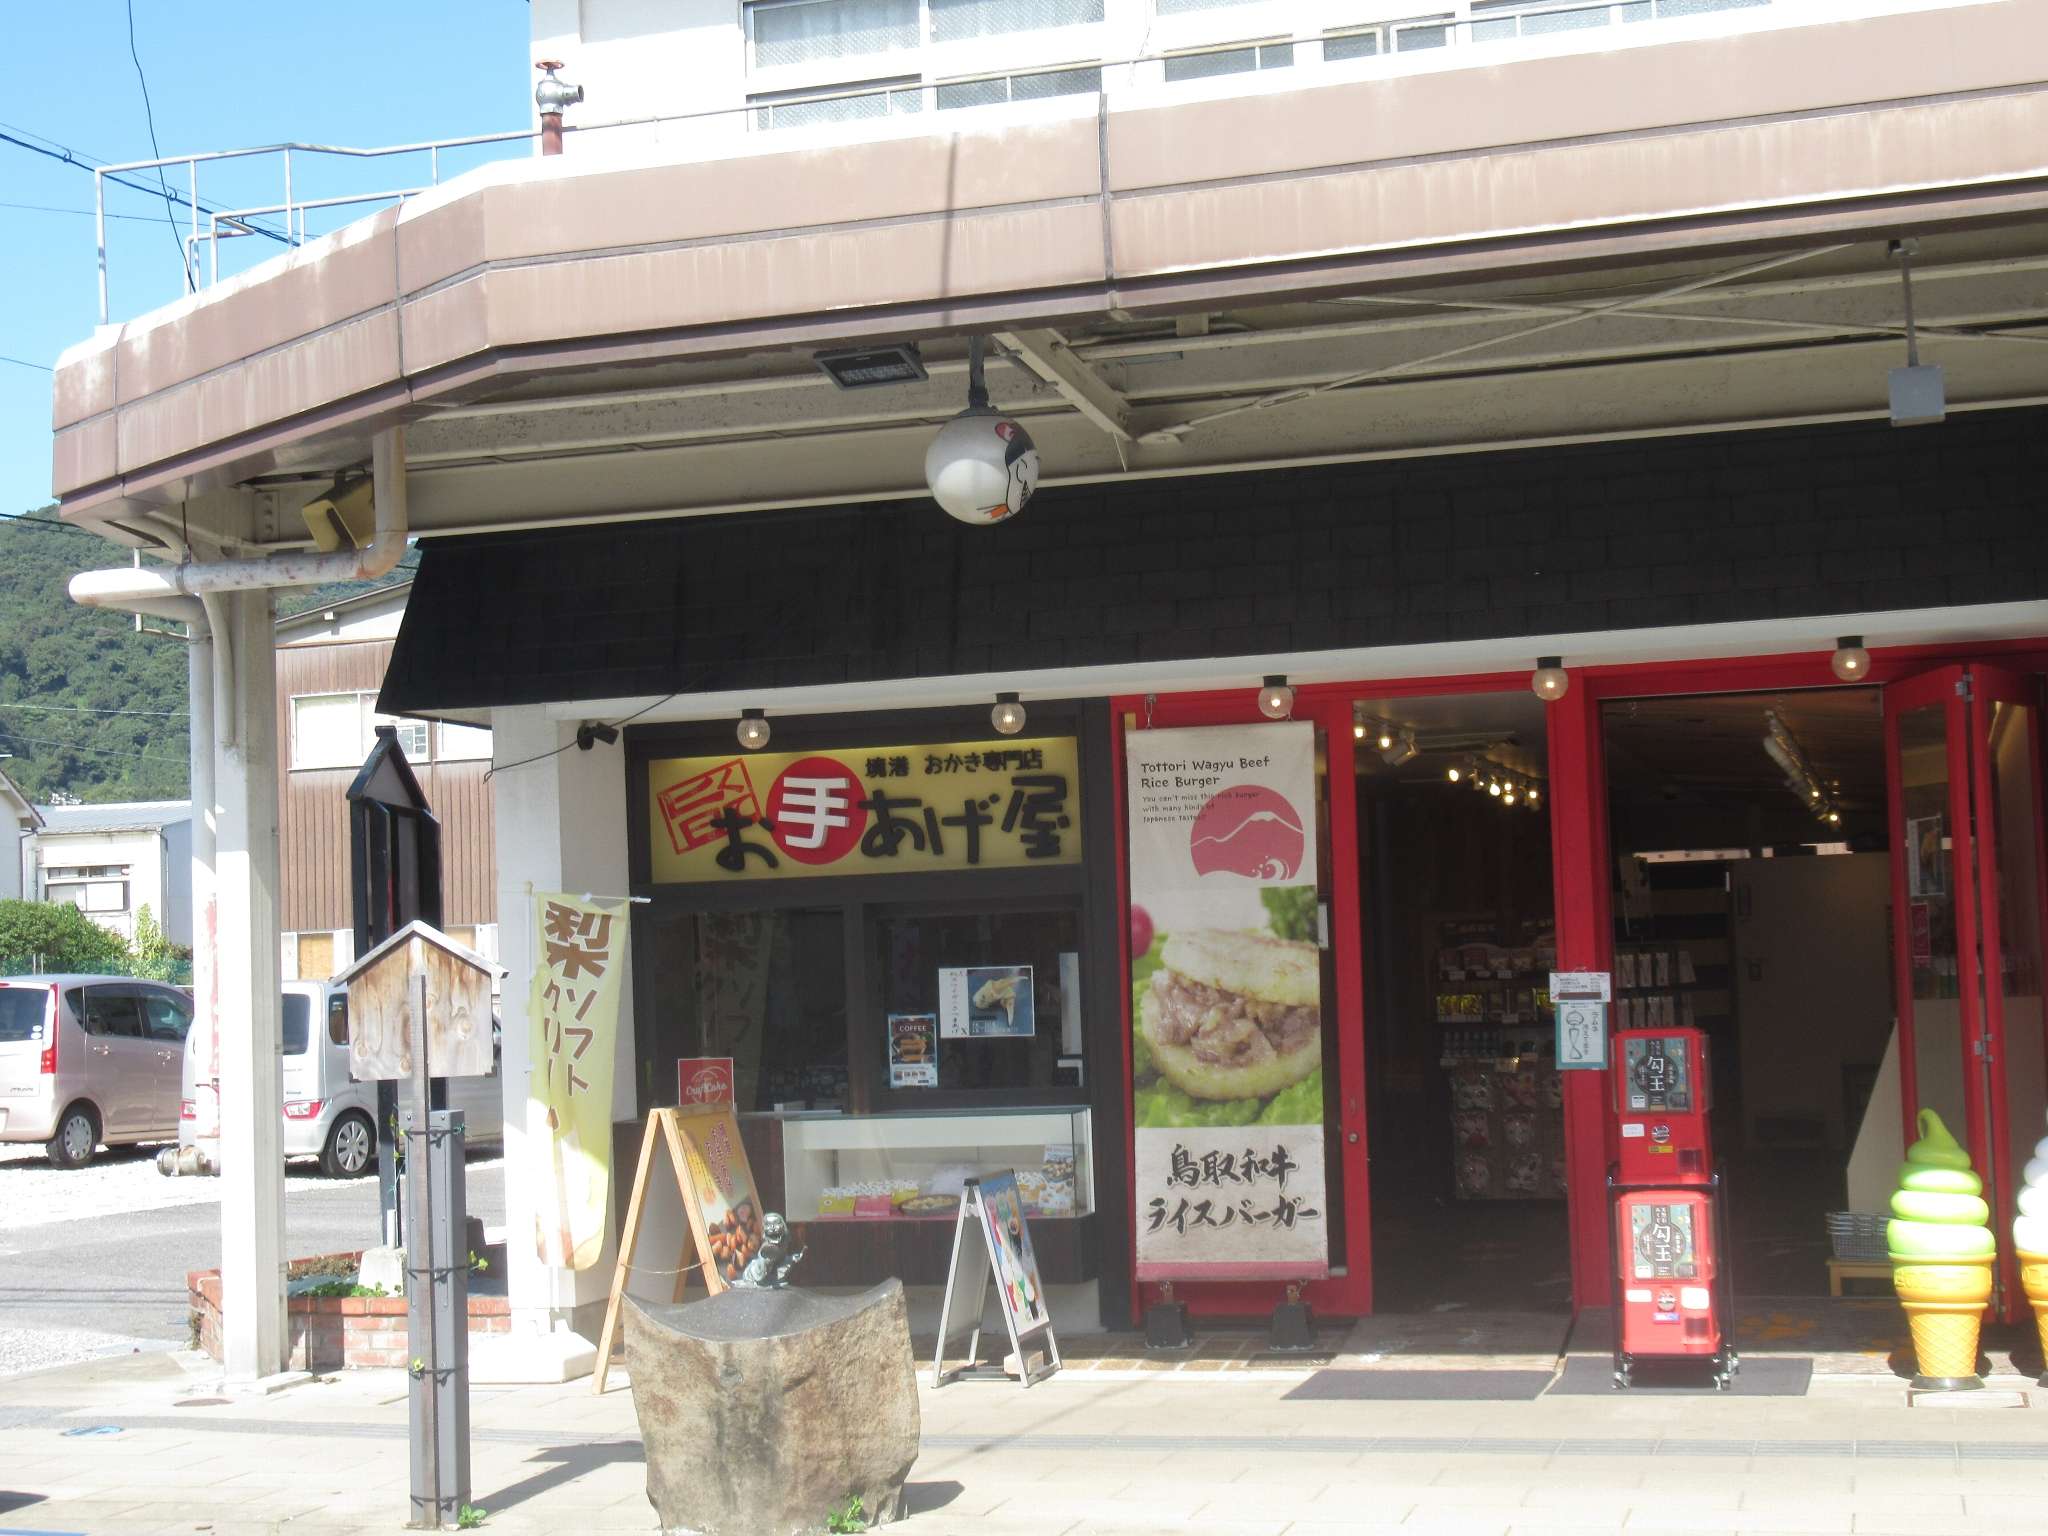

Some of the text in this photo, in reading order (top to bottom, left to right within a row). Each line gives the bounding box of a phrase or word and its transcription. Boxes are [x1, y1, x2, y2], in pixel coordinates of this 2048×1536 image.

[924, 748, 1043, 775] おかき専門店
[1141, 755, 1270, 773] Tottori Wagyu Beef
[1141, 776, 1220, 789] Rice Burger
[711, 775, 1071, 872] お手あげ屋
[545, 901, 612, 979] 梨
[565, 988, 597, 1096] ソフト
[900, 1024, 927, 1032] COFFEE
[1166, 1143, 1297, 1188] 鳥取和牛
[1148, 1193, 1319, 1235] ライスバーガー
